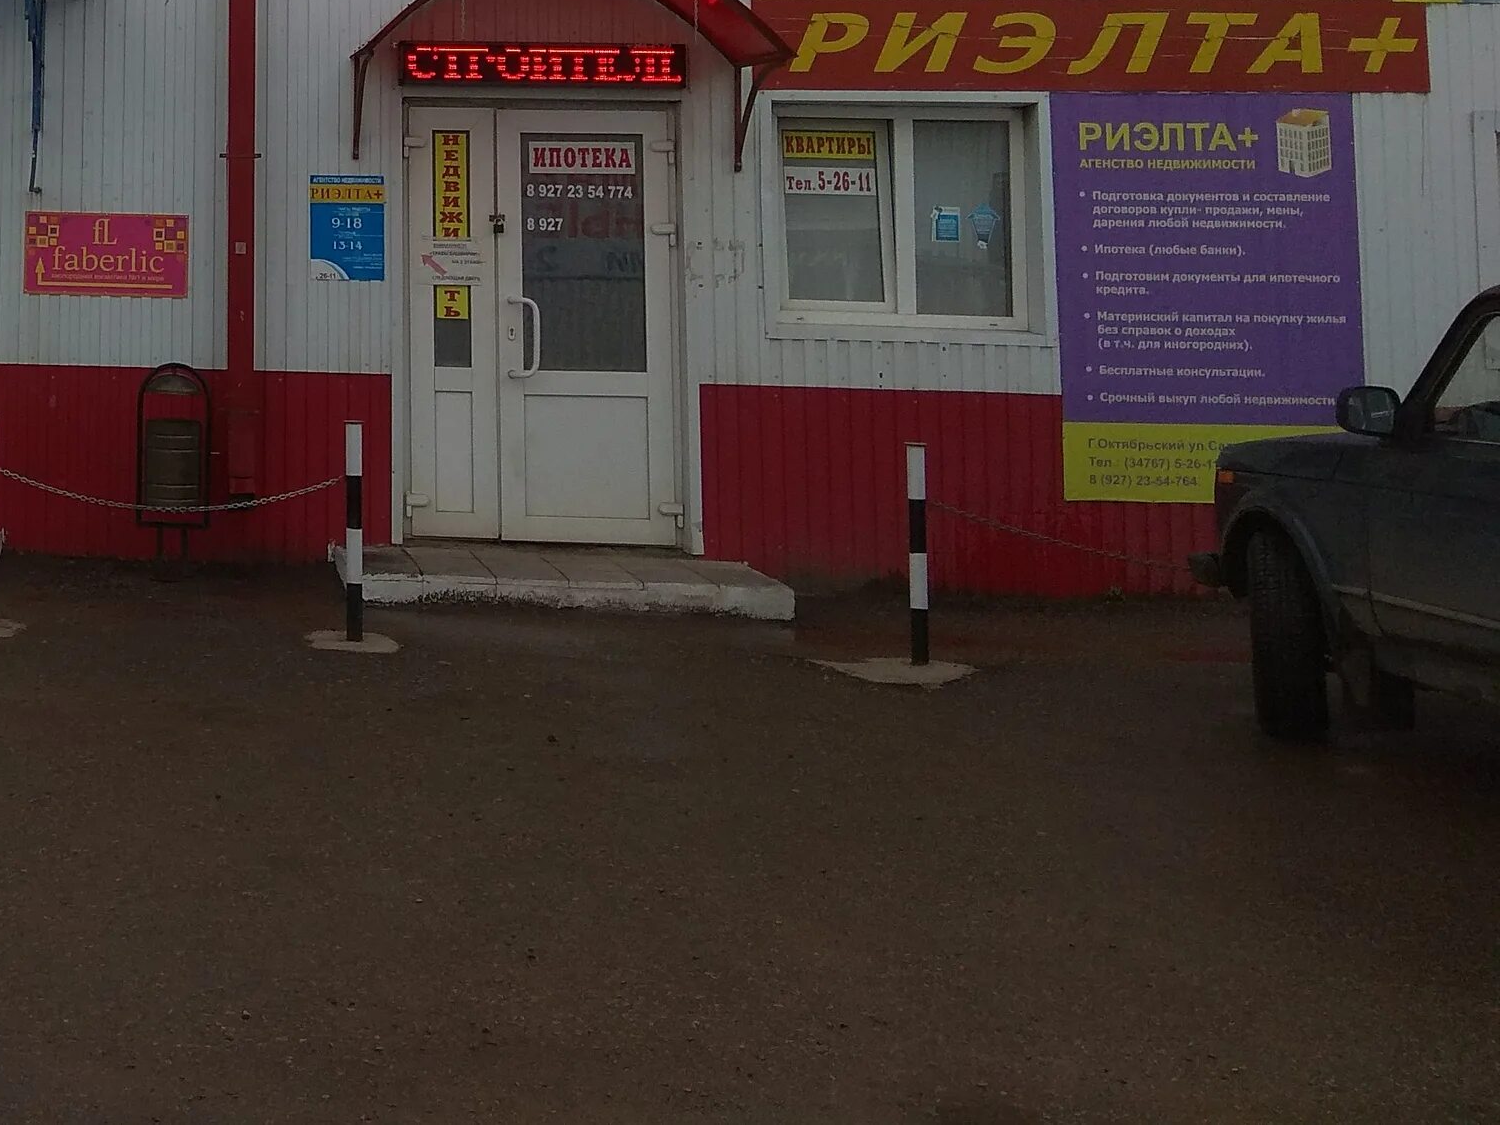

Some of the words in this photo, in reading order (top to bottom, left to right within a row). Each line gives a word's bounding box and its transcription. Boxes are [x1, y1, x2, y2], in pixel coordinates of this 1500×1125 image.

[788, 11, 1417, 76] РИЭЛТА+
[1078, 122, 1258, 152] РИЭЛТА+
[785, 136, 871, 155] КВАРТИРЫ
[532, 147, 631, 168] ИПОТЕКА
[1080, 159, 1143, 169] АГЕНСТВО
[1148, 159, 1256, 170] НЕДВИЖИМОСТИ
[786, 176, 815, 191] Тел.
[818, 171, 871, 192] 5-26-11
[311, 188, 382, 200] РИЭЛТА+
[526, 184, 534, 197] 8
[539, 185, 563, 197] 927
[567, 185, 583, 198] 23
[588, 185, 604, 198] 54
[608, 186, 633, 199] 774
[1092, 191, 1164, 202] Подготовка
[1167, 191, 1240, 203] документов
[1253, 193, 1330, 203] составление
[332, 217, 362, 228] 9-18
[526, 218, 534, 230] 8
[539, 218, 563, 231] 927
[1094, 245, 1146, 255] Ипотека
[52, 246, 164, 273] faberlic
[1097, 311, 1178, 323] Материнский
[1182, 313, 1232, 324] капитал
[1235, 315, 1250, 323] на
[1254, 315, 1302, 326] покупку
